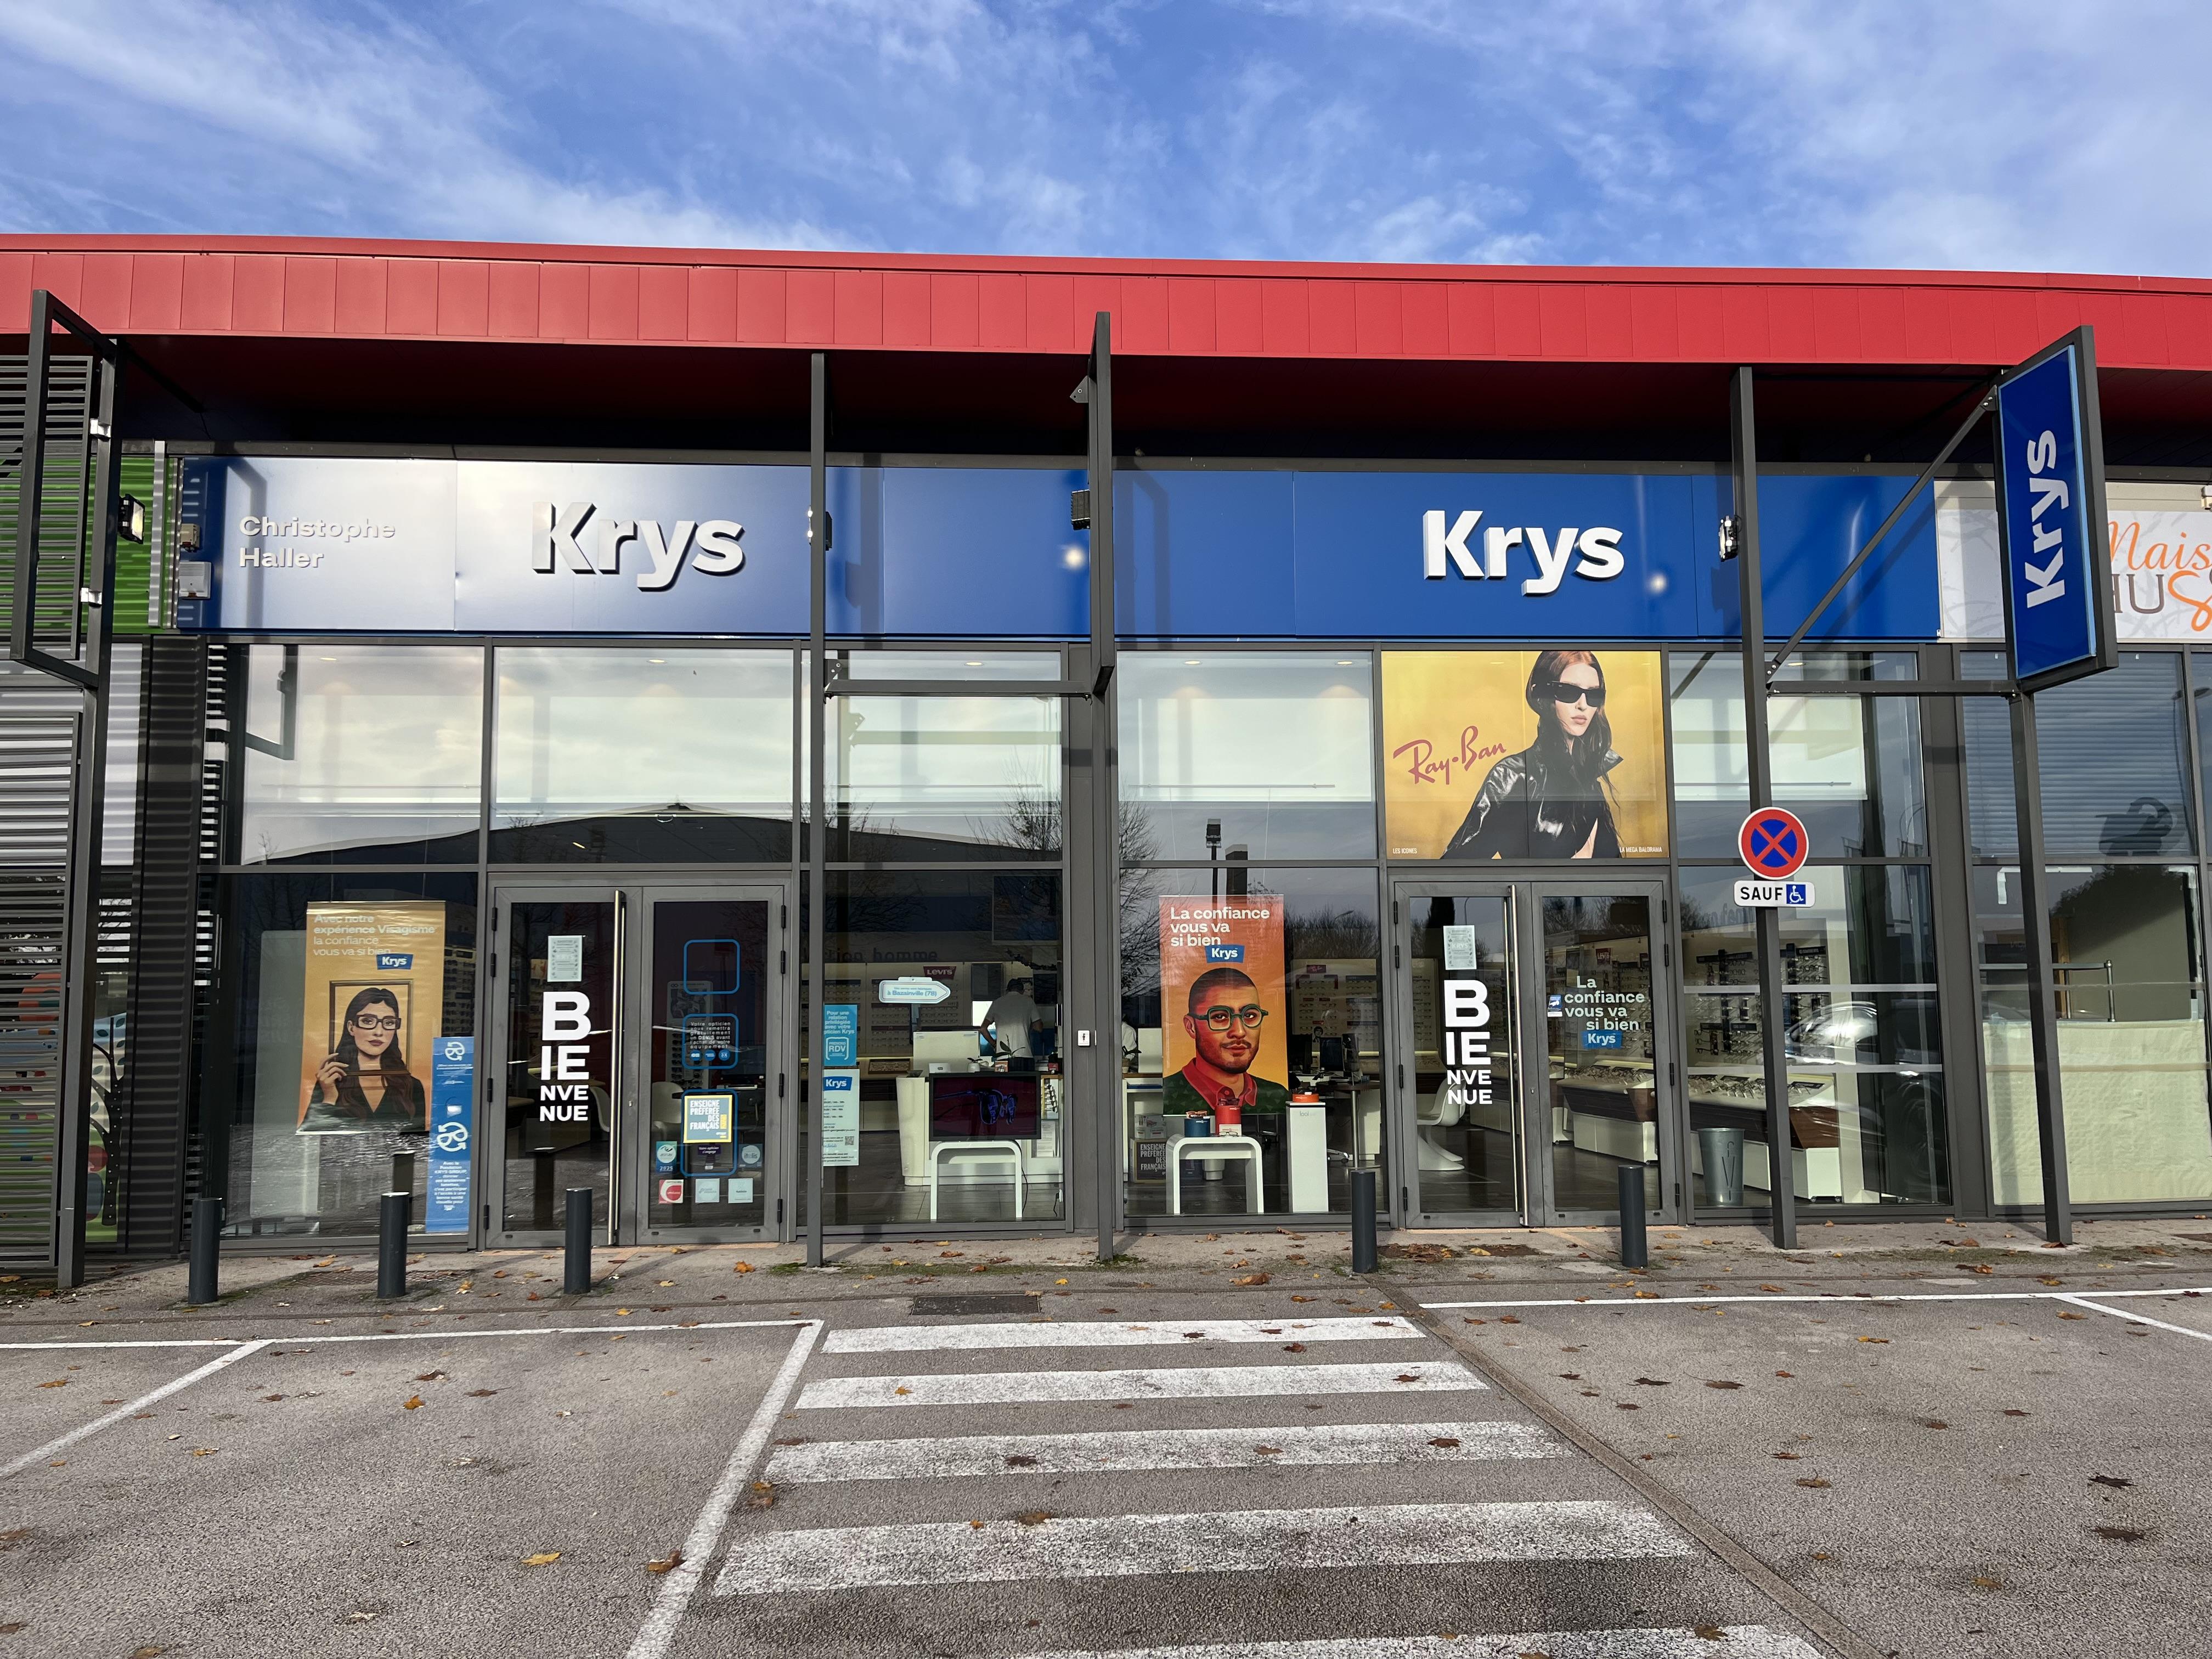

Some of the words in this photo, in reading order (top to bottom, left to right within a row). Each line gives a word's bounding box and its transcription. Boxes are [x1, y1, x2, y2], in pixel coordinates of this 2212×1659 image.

[2025, 430, 2069, 608] Krys
[239, 516, 396, 542] Christophe
[532, 501, 745, 592] Krys
[1423, 510, 1624, 596] Krys
[239, 547, 324, 568] Haller
[1740, 887, 1783, 900] SAUF
[314, 915, 343, 923] Avec
[345, 915, 374, 923] notre
[1171, 907, 1190, 919] La
[1193, 907, 1270, 919] confiance
[314, 925, 375, 935] expérience
[377, 925, 436, 935] Visagisme
[1170, 923, 1208, 933] vous
[1211, 923, 1230, 933] va
[314, 936, 323, 945] la
[325, 936, 379, 945] confiance
[1171, 934, 1183, 946] si
[1187, 934, 1221, 946] bien
[368, 947, 391, 955] bien
[1211, 948, 1238, 960] Krys
[382, 956, 407, 967] Krys
[1577, 975, 1596, 988] La
[1564, 990, 1645, 1003] confiance
[1444, 980, 1490, 1028] B
[542, 991, 591, 1041] B
[1565, 1007, 1604, 1017] vous
[1608, 1007, 1627, 1017] va
[1587, 1018, 1599, 1030] si
[1604, 1018, 1639, 1030] bien
[1588, 1033, 1616, 1046] Krys
[1446, 1031, 1491, 1065] IE
[540, 1045, 590, 1080] IE
[826, 1079, 847, 1088] Krys
[1447, 1070, 1492, 1085] NVE
[540, 1085, 589, 1101] NVE
[1448, 1090, 1492, 1104] NUE
[539, 1105, 588, 1121] NUE
[690, 1122, 719, 1131] FRANÇAIS
[1141, 1163, 1166, 1172] FRANÇAIS
